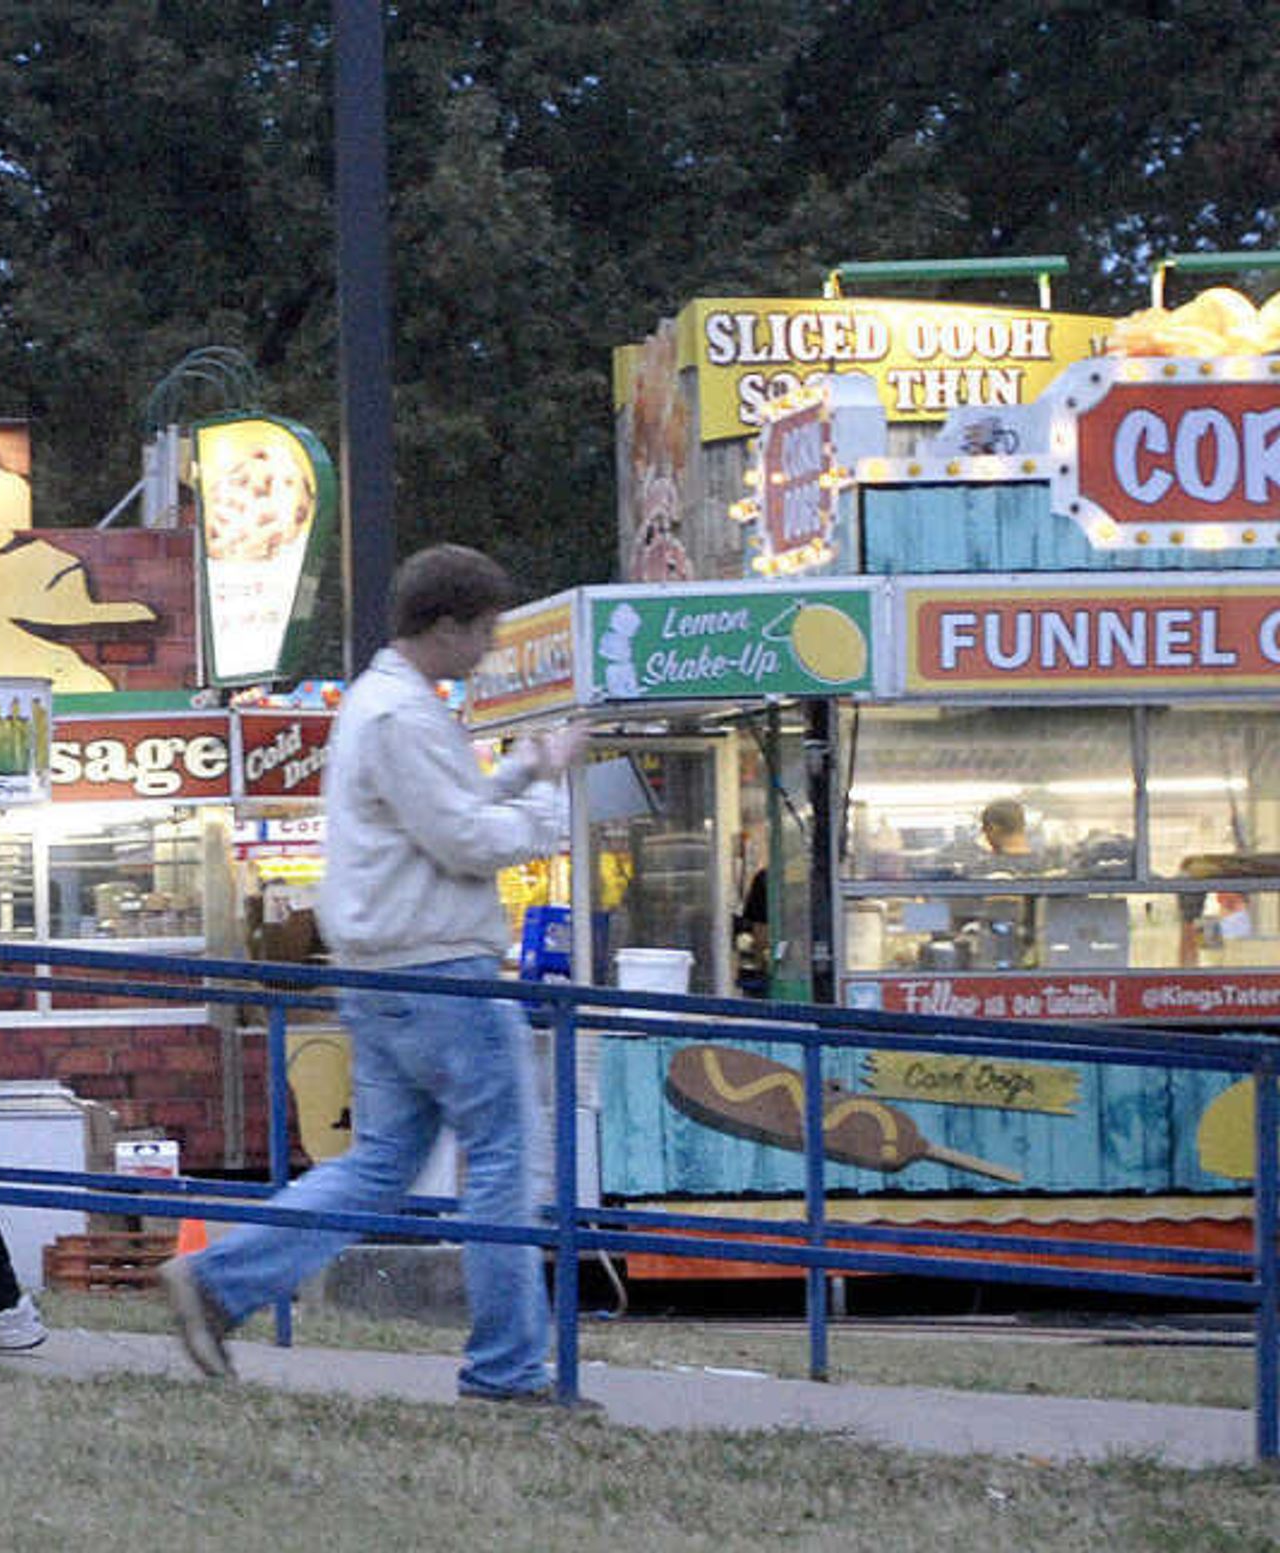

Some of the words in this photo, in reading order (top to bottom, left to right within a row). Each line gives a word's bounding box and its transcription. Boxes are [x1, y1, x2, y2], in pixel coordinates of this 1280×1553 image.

[706, 311, 889, 366] SLICED
[907, 317, 1052, 362] OOOH
[888, 367, 1025, 411] THIN
[1114, 407, 1280, 503] COR
[661, 607, 750, 639] Lemon
[940, 608, 1238, 669] FUNNEL
[245, 722, 302, 783] Cold
